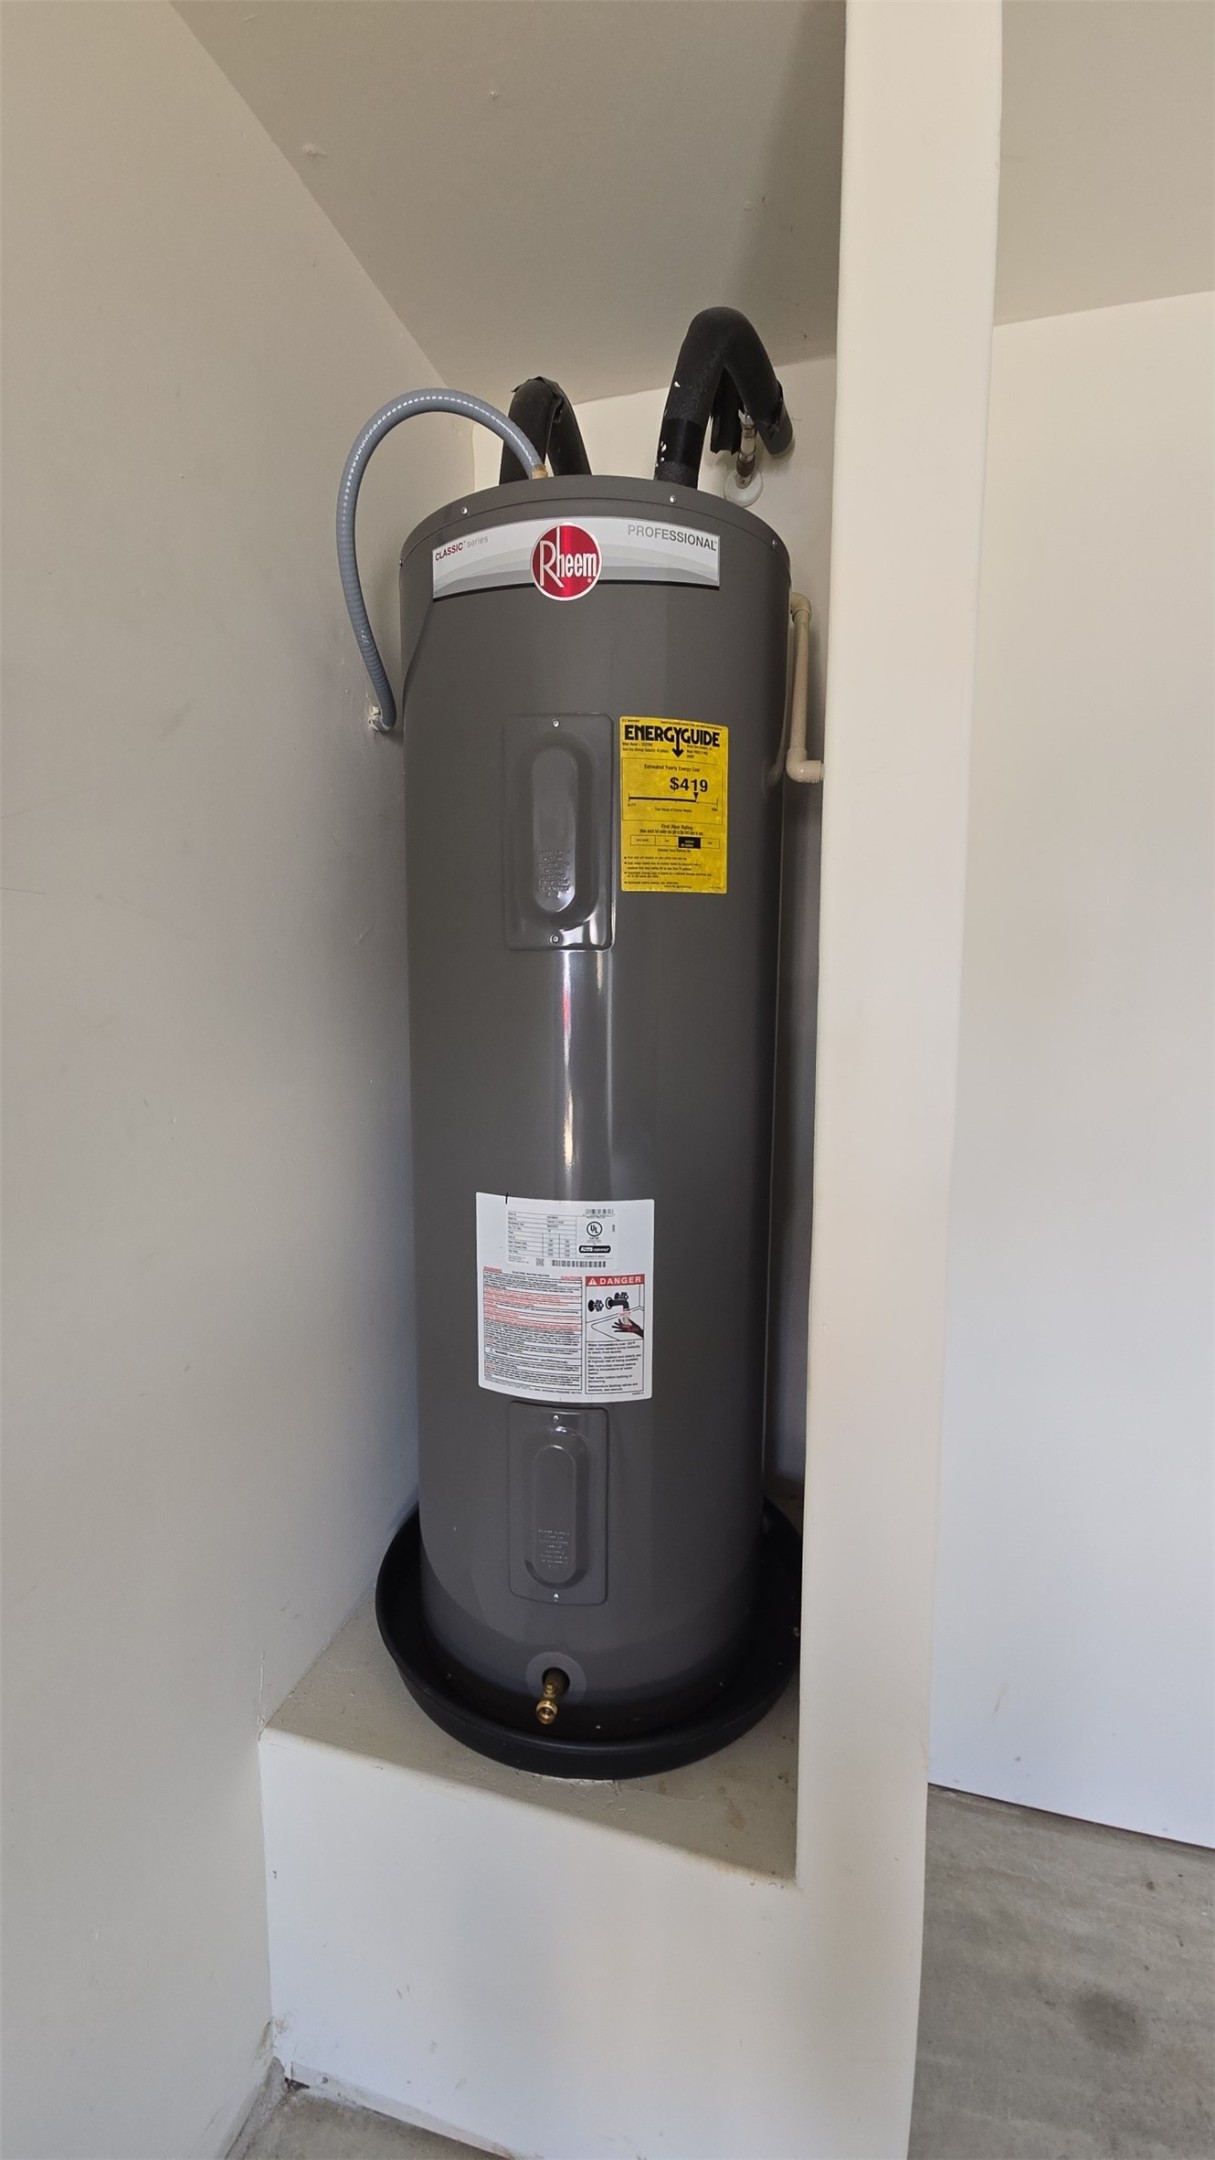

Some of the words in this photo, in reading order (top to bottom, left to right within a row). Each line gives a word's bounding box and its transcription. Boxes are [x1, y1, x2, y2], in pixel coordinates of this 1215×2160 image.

[434, 542, 464, 561] CLASSIC
[466, 536, 489, 548] series
[627, 524, 717, 552] PROFESSIONAL
[539, 526, 597, 588] Rheem
[624, 725, 720, 748] ENERGYGUIDE
[669, 777, 708, 792] $419
[600, 1276, 642, 1285] DANGER
